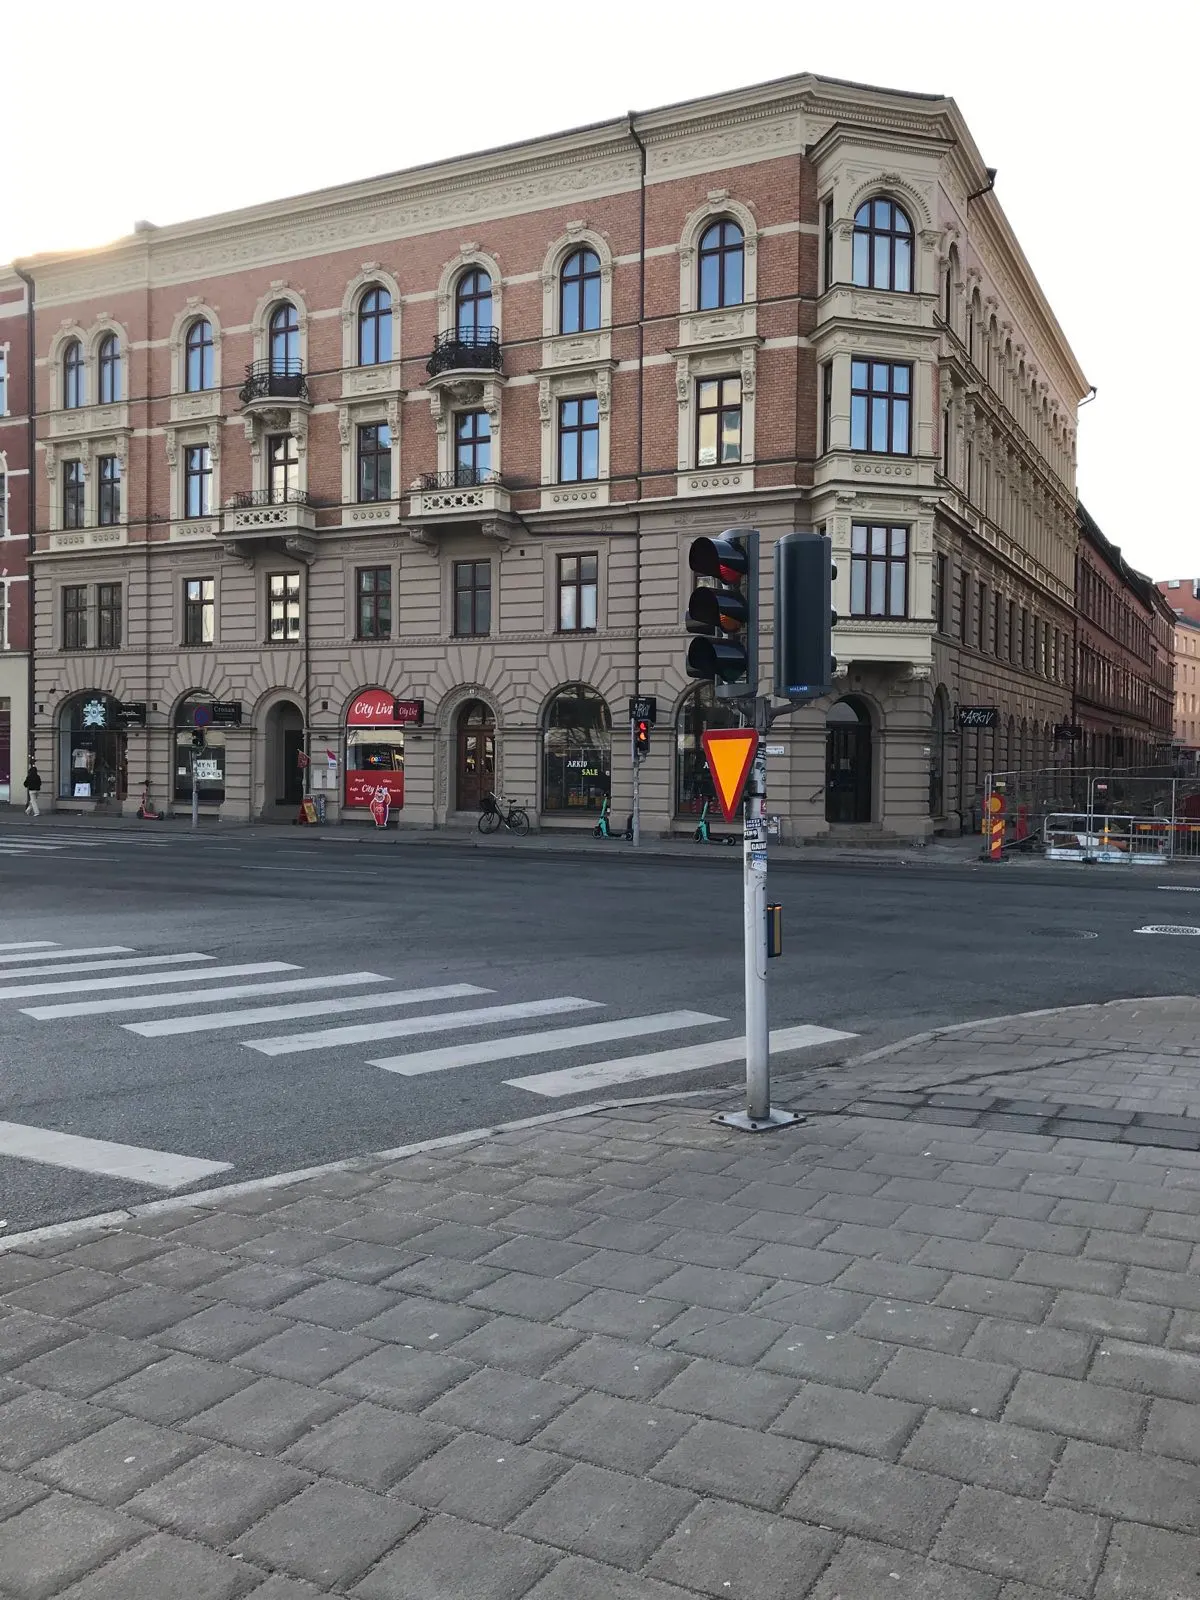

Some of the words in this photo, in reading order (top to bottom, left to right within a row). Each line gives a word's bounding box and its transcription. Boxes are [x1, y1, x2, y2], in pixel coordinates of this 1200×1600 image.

[355, 702, 374, 718] City
[376, 702, 394, 715] Livs
[581, 768, 598, 776] SALE
[361, 784, 374, 796] City
